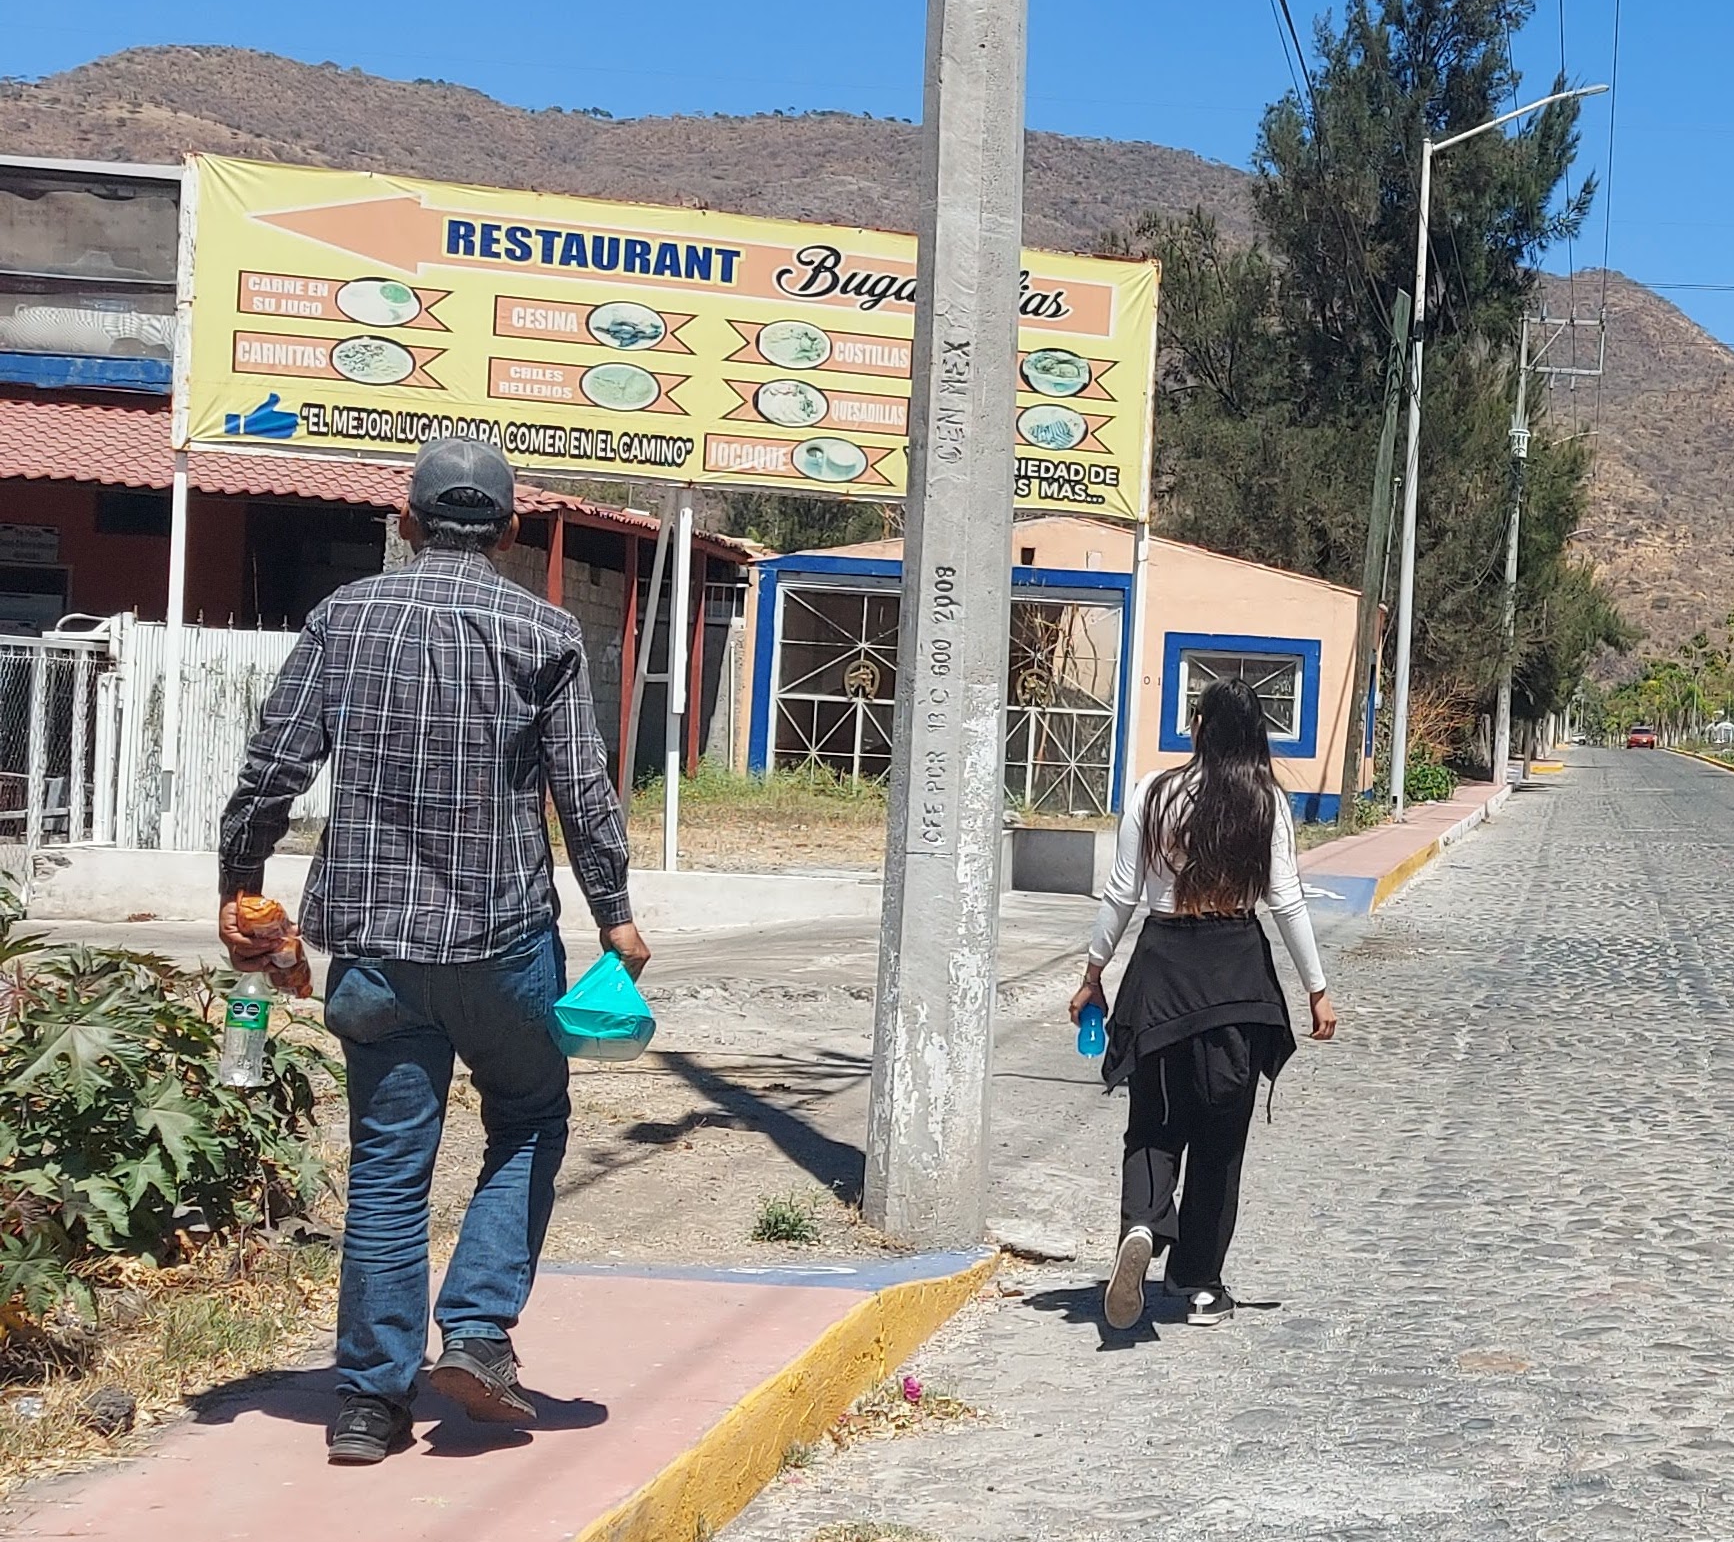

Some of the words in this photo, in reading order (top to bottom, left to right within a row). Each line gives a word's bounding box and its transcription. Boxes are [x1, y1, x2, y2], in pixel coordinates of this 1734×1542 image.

[447, 219, 741, 284] RESTAURANT
[248, 276, 305, 296] CARNE
[308, 282, 329, 297] EN
[252, 297, 276, 312] SU
[280, 299, 322, 316] JUGO
[511, 307, 578, 333] CESINA
[238, 340, 327, 369] CARNITAS
[833, 342, 909, 369] COSTILLAS
[831, 400, 905, 426] QUESADILLAS
[332, 409, 393, 439] MEJOR
[397, 414, 453, 442] LUGAR
[506, 425, 566, 455] COMER
[570, 430, 592, 457] EN
[597, 432, 615, 459] EL
[1090, 467, 1118, 485] DE
[931, 639, 952, 676] 600
